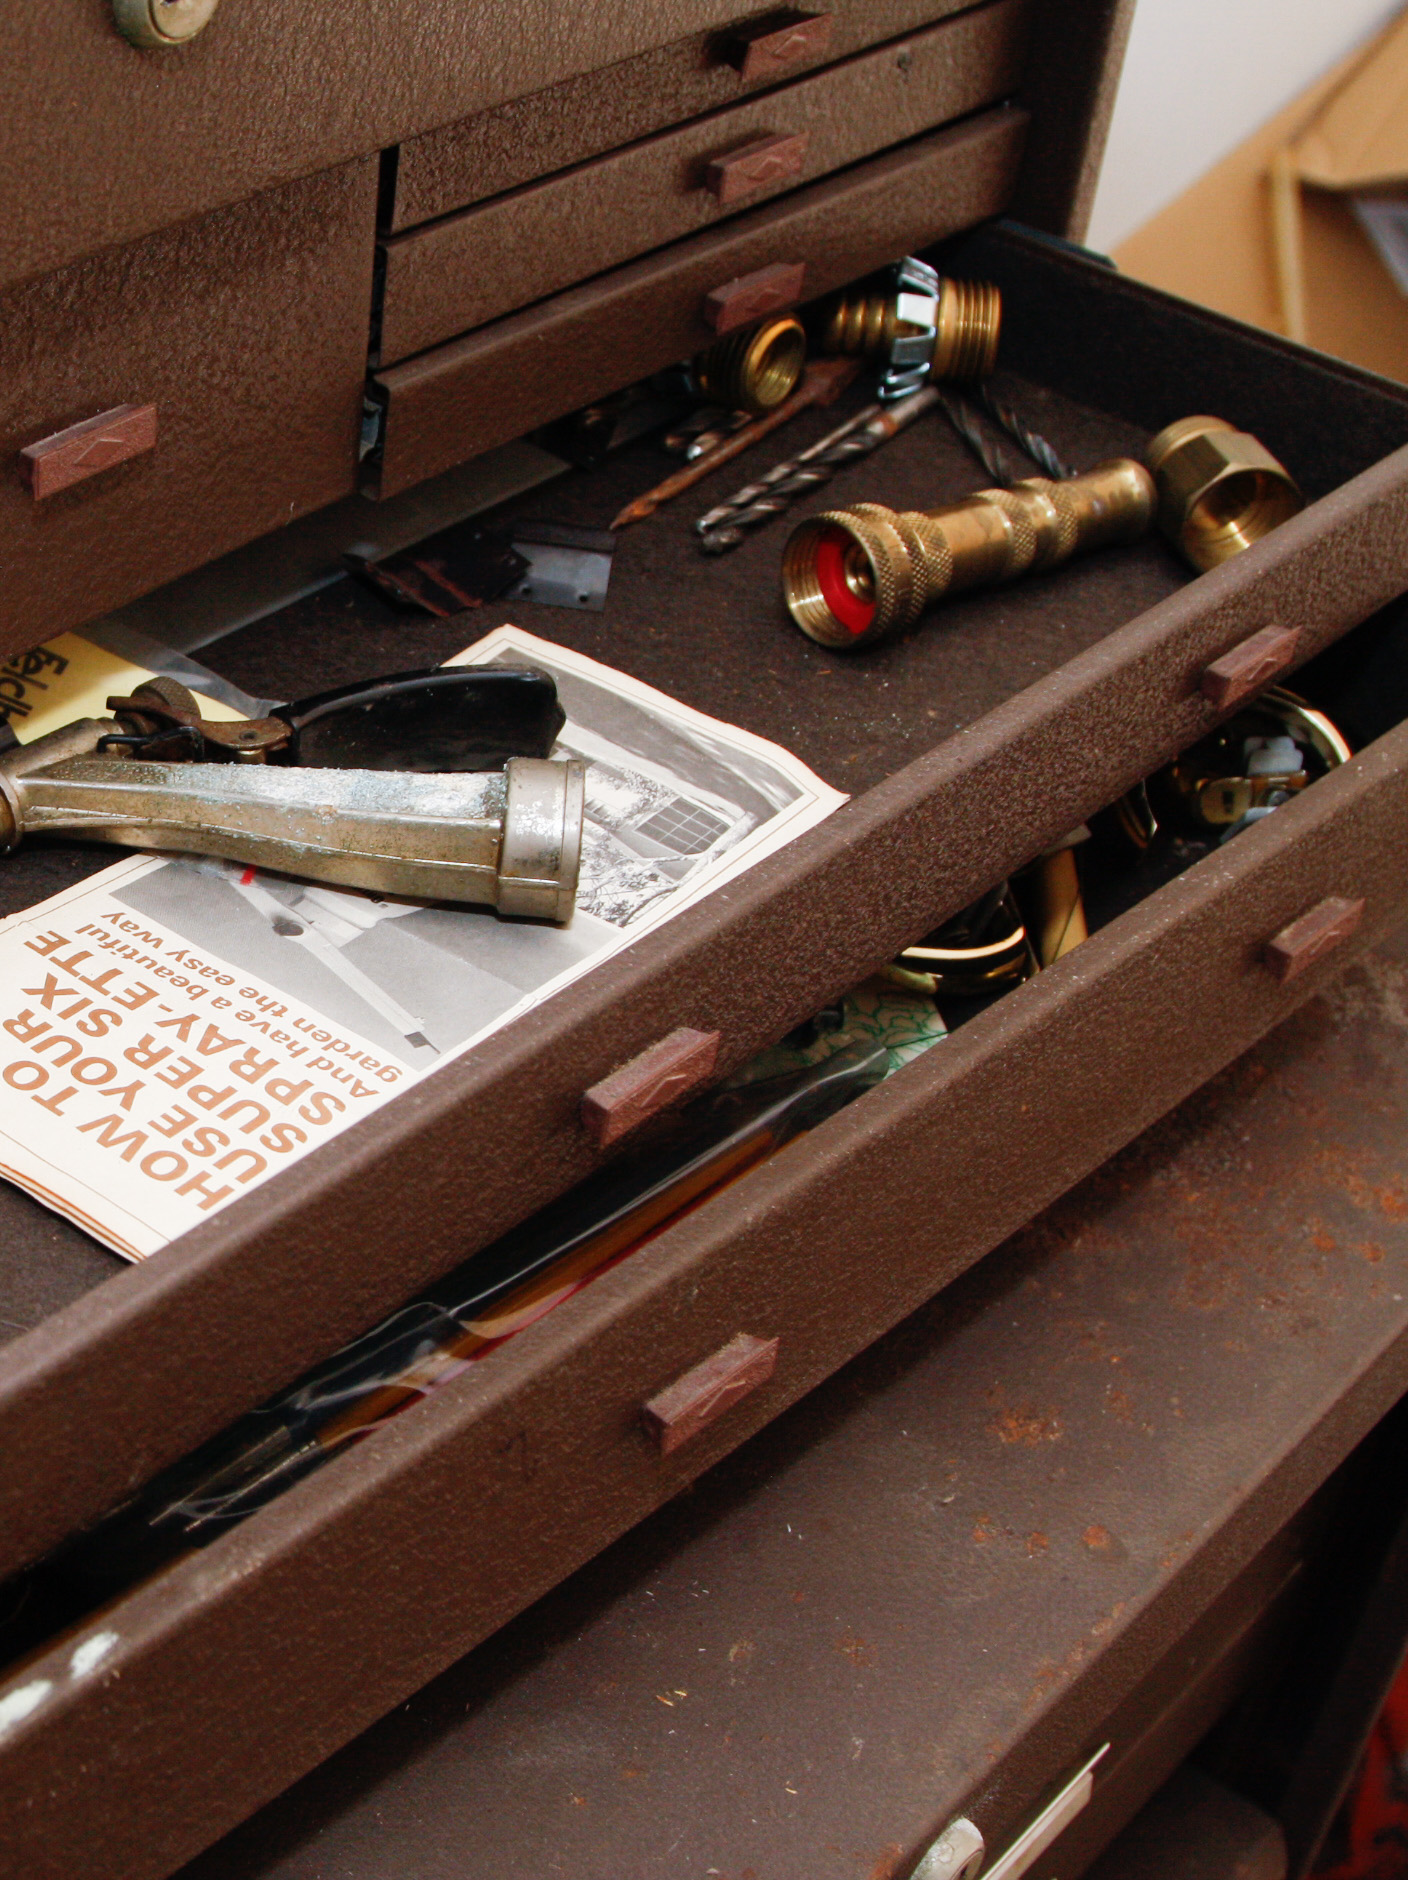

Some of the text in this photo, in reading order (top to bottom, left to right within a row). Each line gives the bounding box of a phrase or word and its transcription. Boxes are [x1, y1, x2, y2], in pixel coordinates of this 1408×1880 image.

[22, 973, 307, 1153] SUPER SIX
[75, 923, 379, 1099] And have a beautiful
[100, 911, 403, 1083] garden the easy way
[2, 1009, 267, 1184] USE YOUR
[3, 1060, 233, 1210] HOW TO
